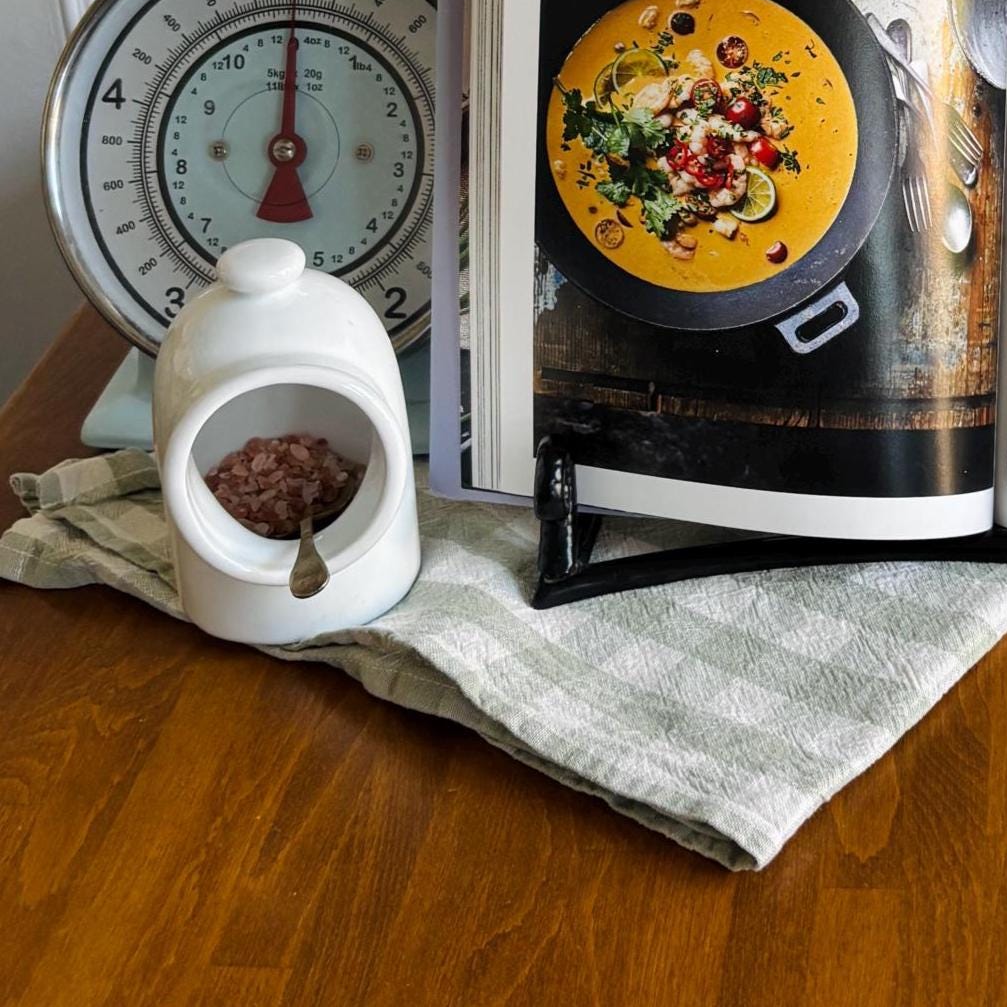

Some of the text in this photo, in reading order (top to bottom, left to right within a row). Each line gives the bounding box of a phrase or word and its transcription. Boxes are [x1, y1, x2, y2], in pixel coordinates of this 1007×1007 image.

[163, 14, 181, 32] 400
[408, 14, 428, 34] 600
[132, 48, 152, 65] 200
[222, 54, 246, 70] 10
[304, 68, 322, 80] 20g
[101, 78, 126, 110] 4
[306, 82, 323, 92] 1oz
[204, 100, 216, 116] 9
[386, 102, 398, 118] 2
[102, 135, 123, 146] 800
[176, 159, 188, 175] 8
[392, 162, 404, 178] 3
[103, 180, 124, 191] 600
[116, 220, 136, 236] 400
[201, 218, 212, 234] 7
[366, 218, 378, 234] 4
[138, 257, 158, 276] 200
[312, 251, 325, 268] 5
[164, 286, 185, 318] 3
[384, 286, 408, 320] 2
